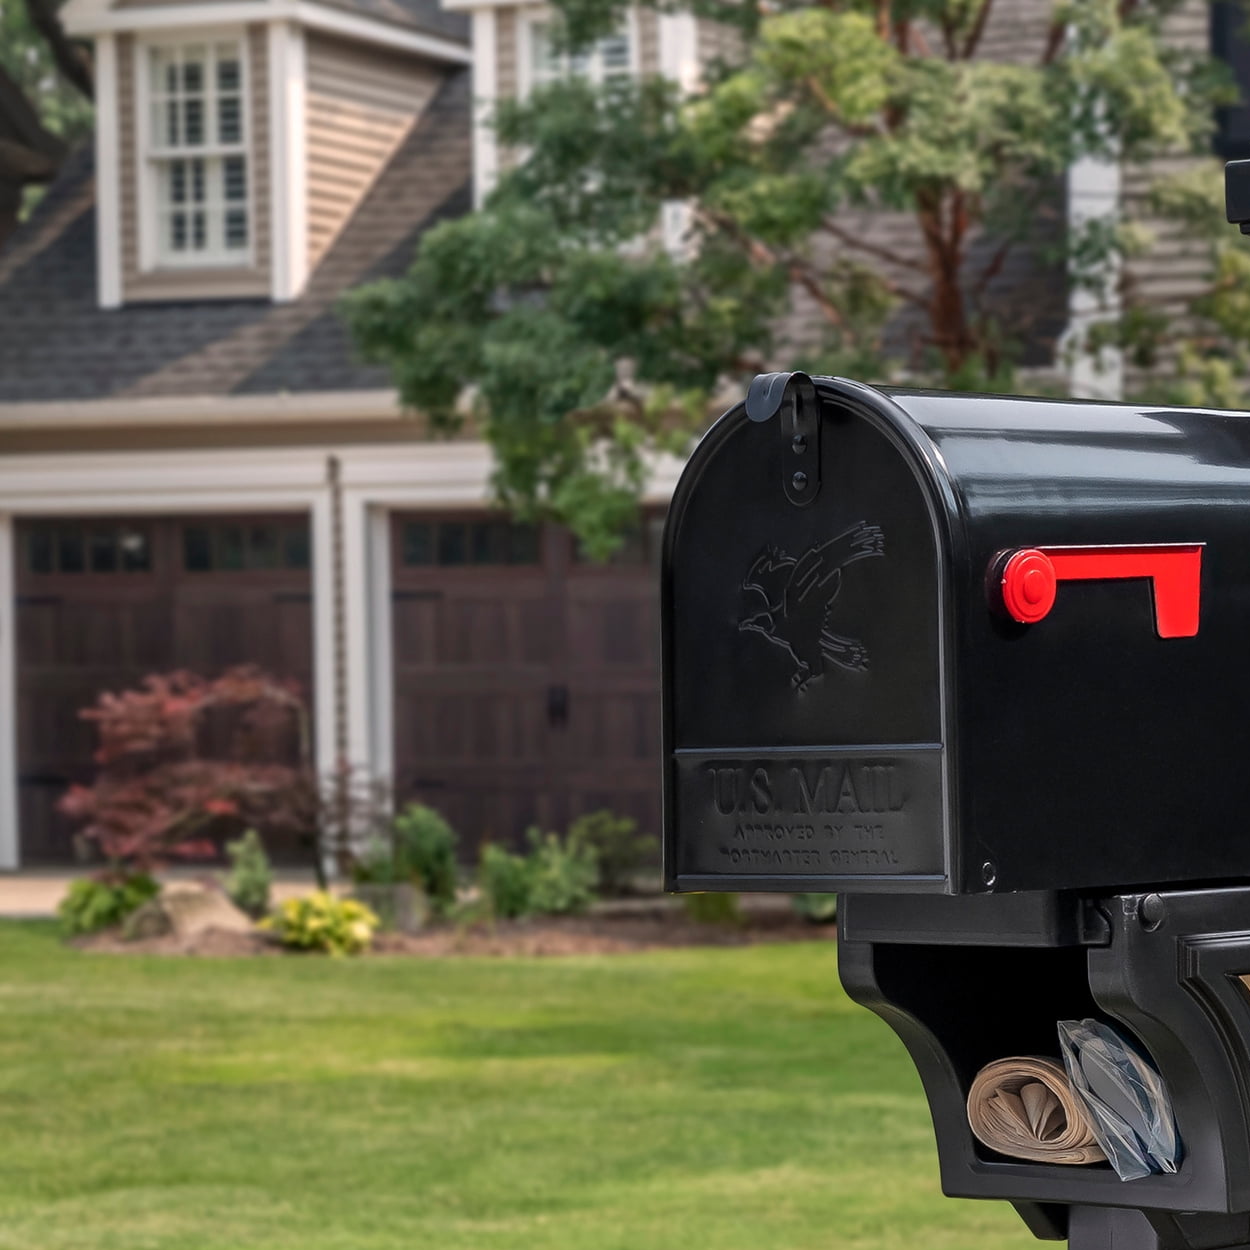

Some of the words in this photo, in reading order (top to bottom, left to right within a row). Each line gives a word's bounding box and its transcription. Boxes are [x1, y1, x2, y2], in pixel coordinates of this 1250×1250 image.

[707, 765, 783, 816] U.S.
[790, 764, 906, 816] MAIL
[853, 823, 885, 840] THE
